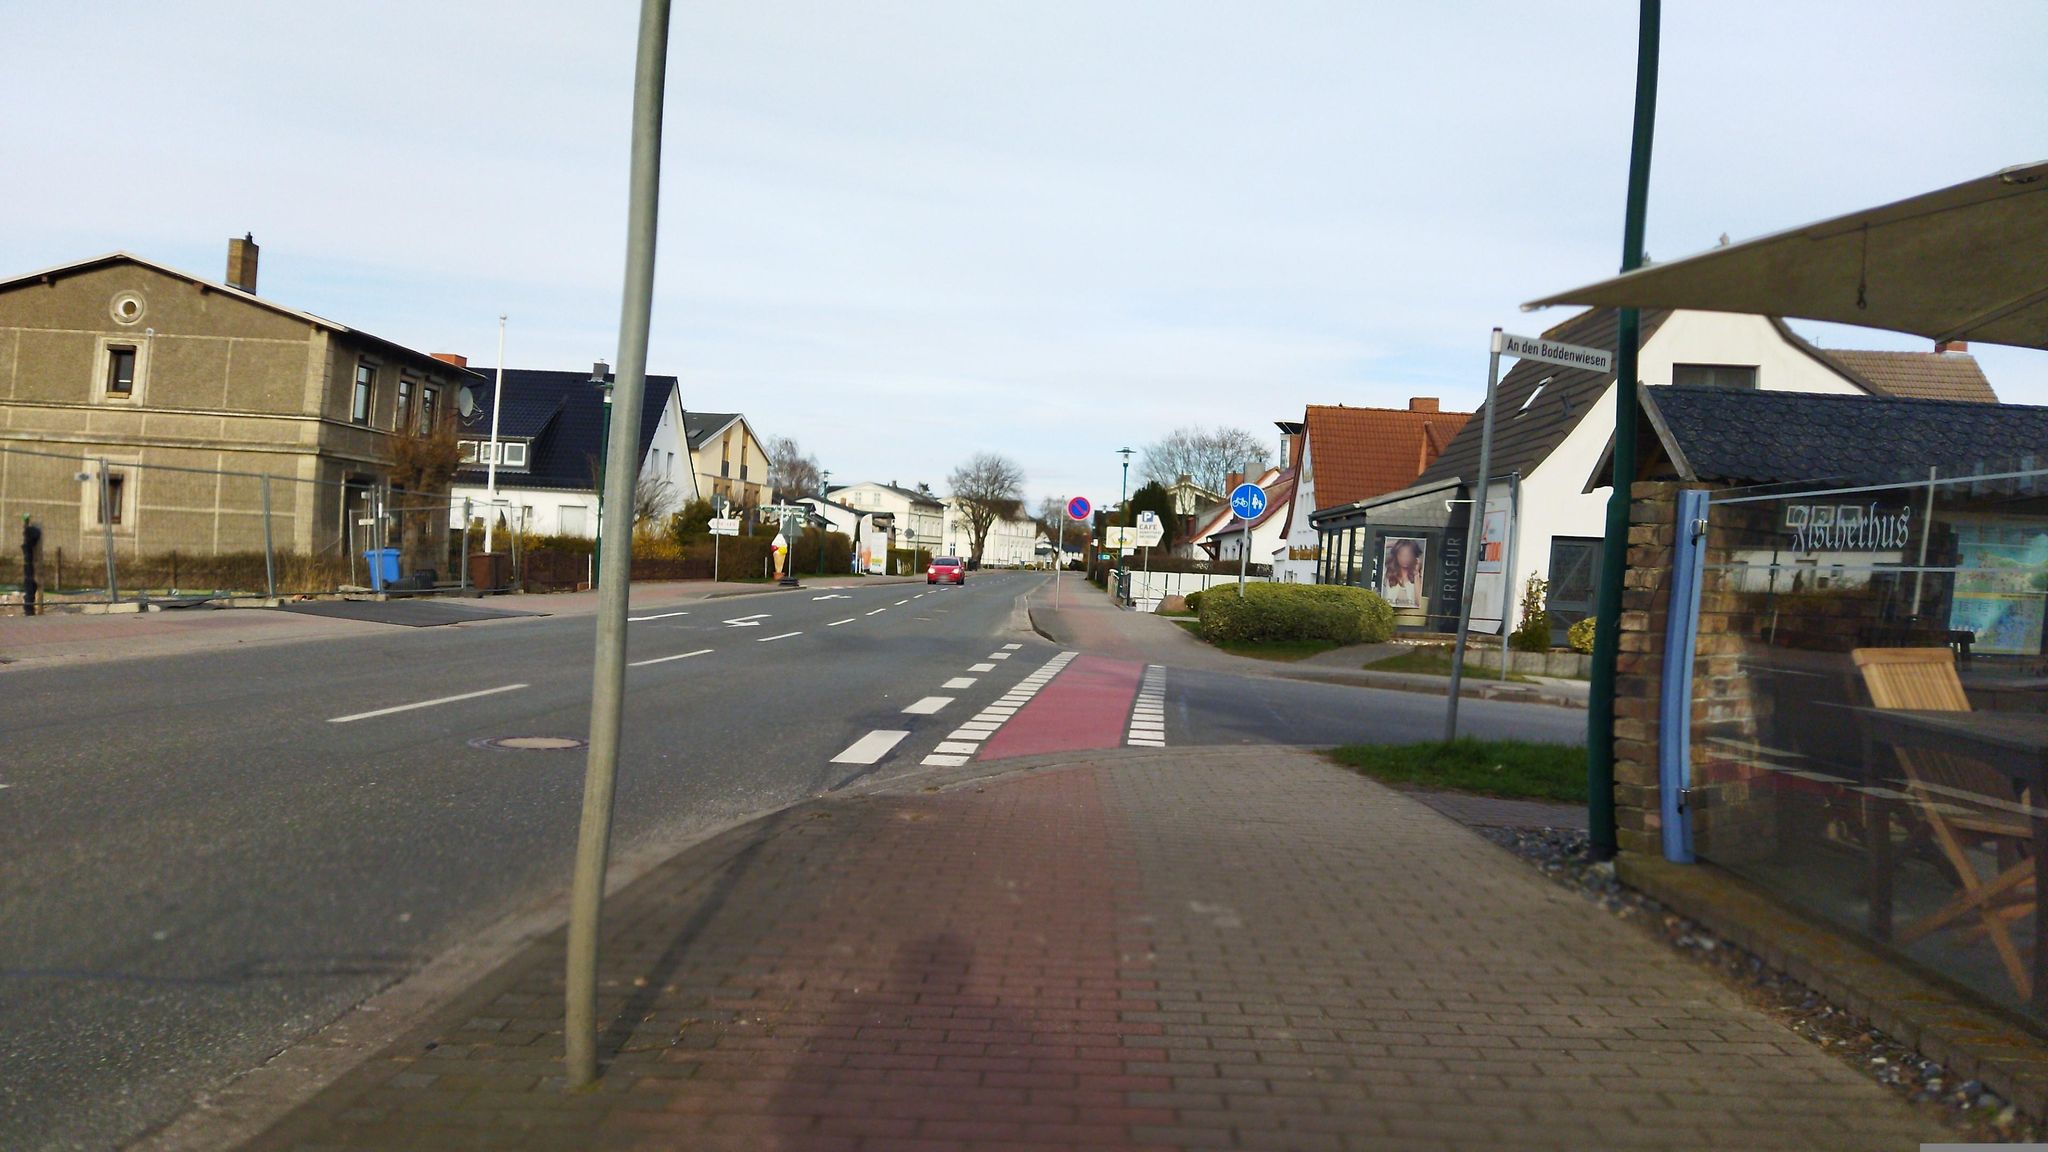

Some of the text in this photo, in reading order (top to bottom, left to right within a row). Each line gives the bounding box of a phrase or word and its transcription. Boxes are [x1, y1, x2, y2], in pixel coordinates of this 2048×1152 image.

[1507, 338, 1606, 367] An den Boddenwiesen
[1143, 512, 1153, 521] P
[1792, 501, 1911, 552] Fischerhus
[1443, 537, 1461, 601] FRISEUR
